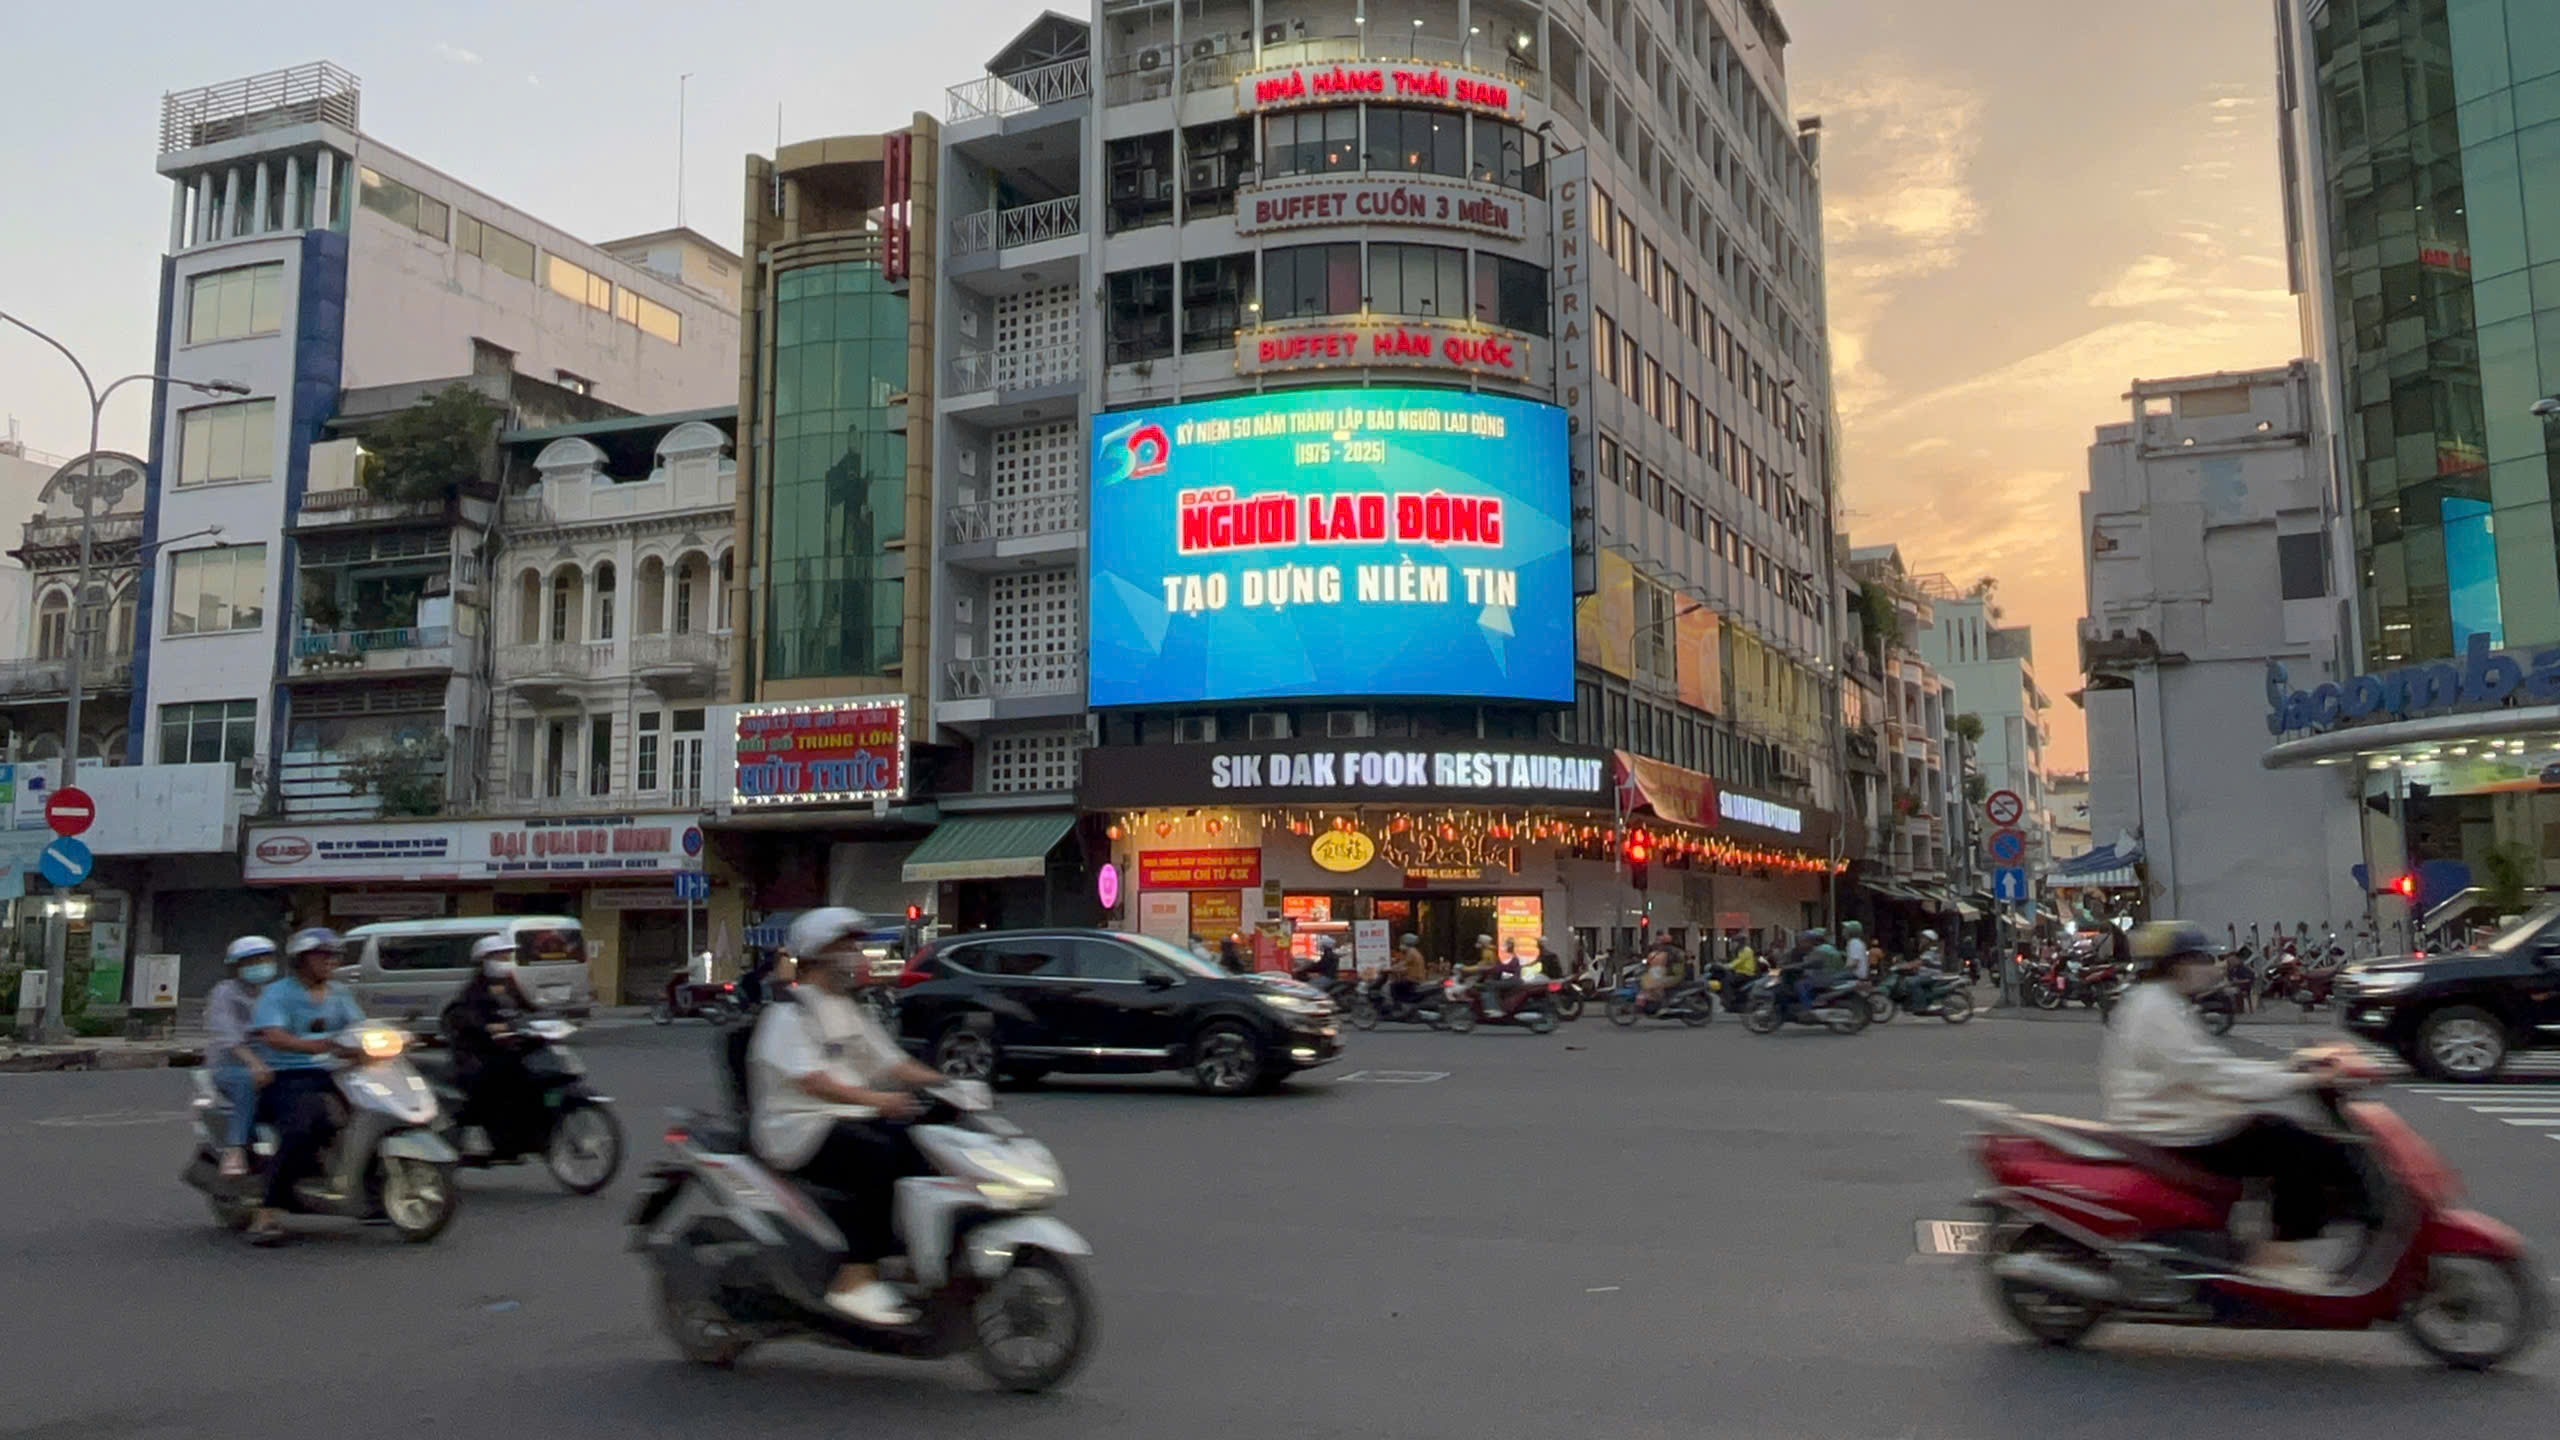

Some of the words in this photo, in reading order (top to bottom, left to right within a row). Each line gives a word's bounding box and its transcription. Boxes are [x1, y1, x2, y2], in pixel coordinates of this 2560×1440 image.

[1256, 69, 1306, 104] NHÀ
[1312, 66, 1385, 95] HÀNG
[1392, 68, 1448, 98] THÁI
[1456, 78, 1508, 109] SIAM
[1256, 193, 1347, 223] BUFFET
[1356, 187, 1426, 217] CUỐN
[1436, 197, 1450, 219] 3
[1458, 197, 1509, 229] MIỀN
[1559, 180, 1580, 371] CENTRAL
[1259, 333, 1358, 363] BUFFET
[1373, 327, 1432, 356] HÀN
[1443, 334, 1515, 368] QUỐC
[1290, 410, 1336, 434] THÀNH
[1366, 409, 1396, 431] BÁO
[1444, 412, 1469, 434] LAO
[1181, 488, 1233, 506] BÁO
[1180, 493, 1298, 553] NGƯỜI
[1307, 494, 1387, 543] LAO
[1395, 490, 1502, 547] ĐỘNG
[1162, 571, 1228, 618] TẠO
[1242, 562, 1342, 612] DỰNG
[1357, 552, 1449, 603] NIỀM
[1462, 566, 1517, 607] TIN
[1211, 755, 1262, 788] SIK
[1269, 753, 1336, 787] DAK
[1343, 752, 1428, 786] FOOK
[1434, 752, 1602, 791] RESTAURANT
